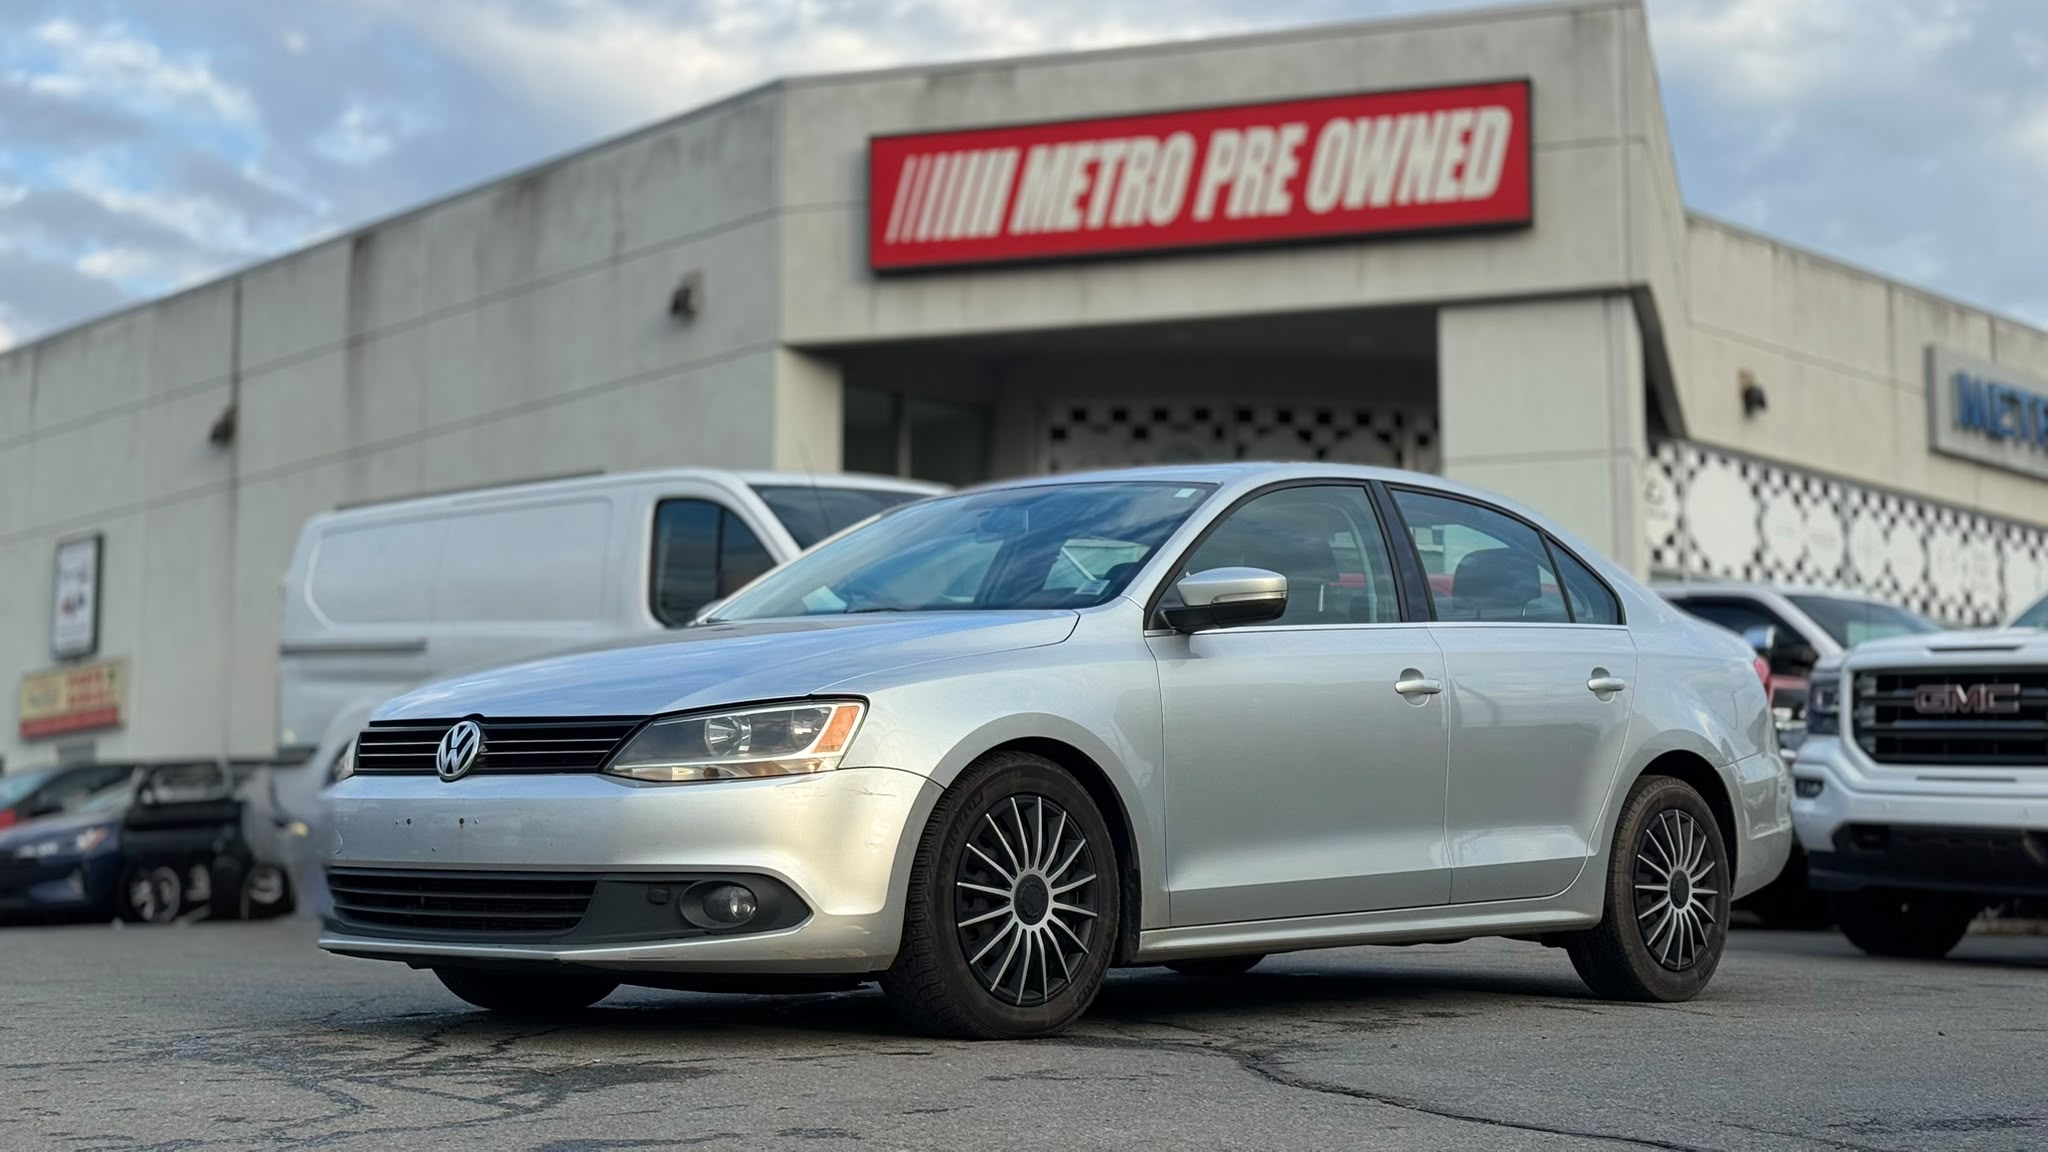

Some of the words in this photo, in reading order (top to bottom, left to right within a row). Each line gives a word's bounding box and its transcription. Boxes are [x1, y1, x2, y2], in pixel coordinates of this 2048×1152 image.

[1008, 132, 1196, 233] METRO
[1194, 123, 1307, 222] PRE
[1306, 106, 1512, 214] OWNED
[1915, 683, 2020, 714] GMC
